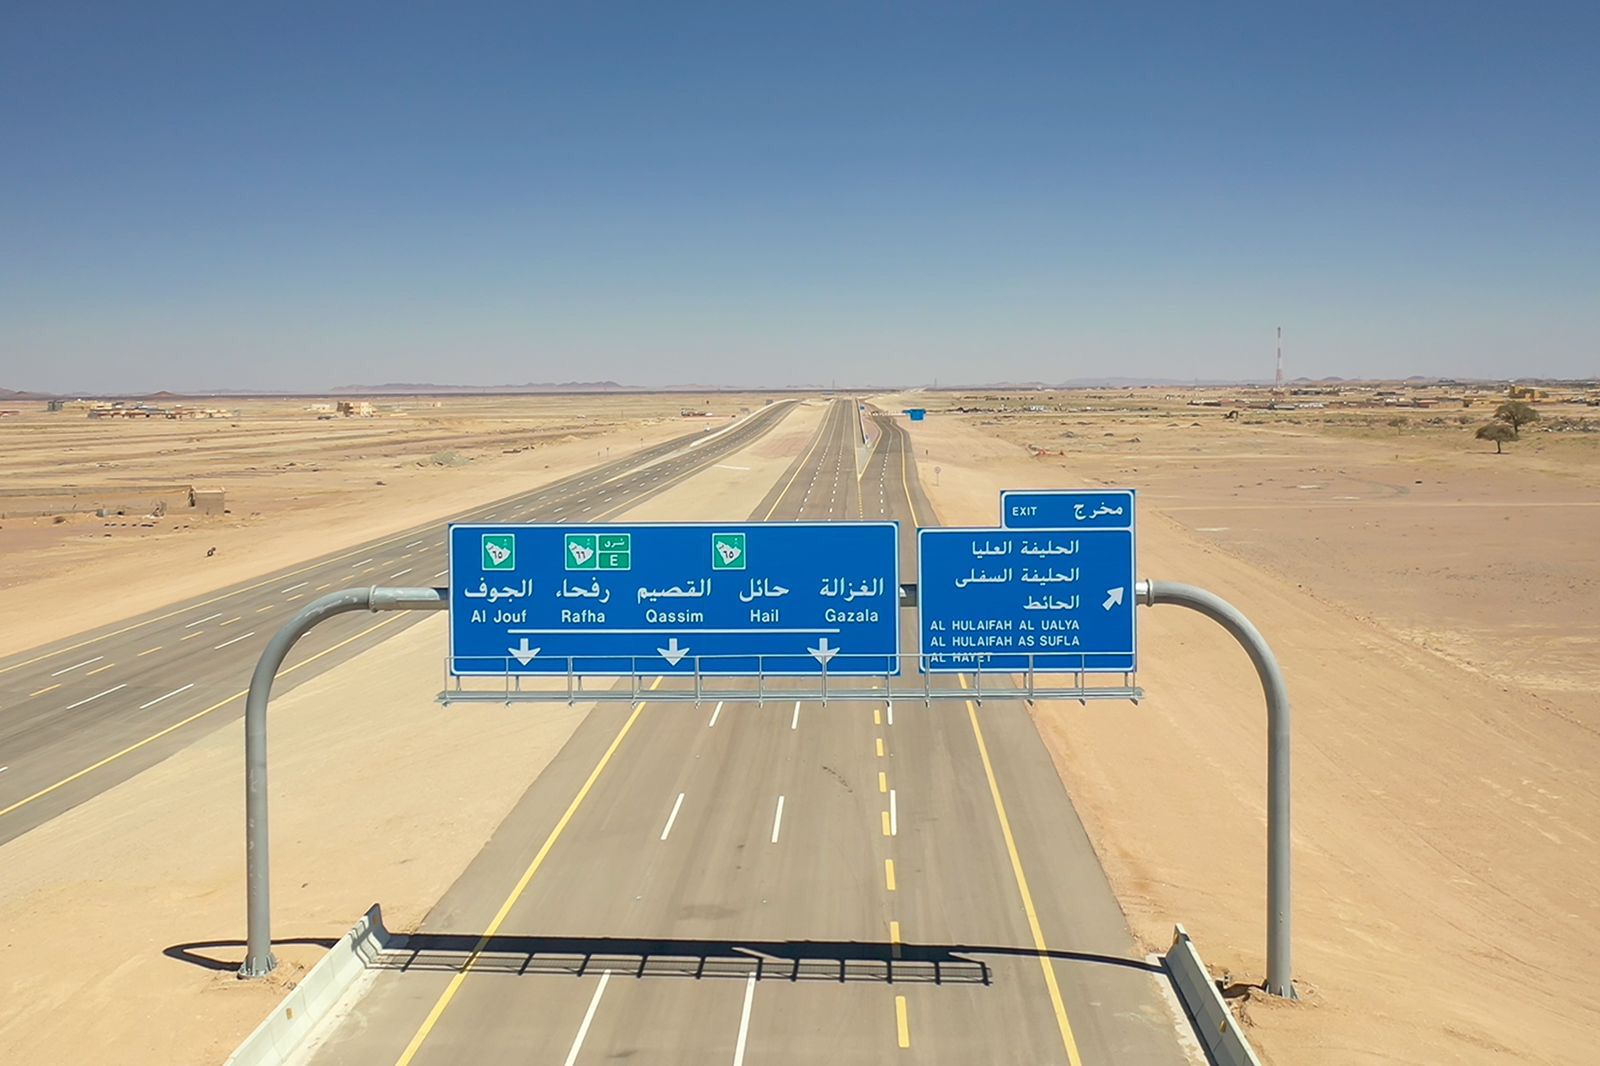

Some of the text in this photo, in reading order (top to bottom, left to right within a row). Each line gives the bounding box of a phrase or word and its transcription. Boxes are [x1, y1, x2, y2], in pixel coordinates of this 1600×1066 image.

[1012, 506, 1037, 516] EXIT
[1073, 502, 1123, 520] مخرج
[972, 540, 1079, 559] الحليفة العليا
[610, 554, 618, 567] E
[955, 567, 1079, 588] الحليفة السفلى
[464, 577, 533, 603] الجوف
[556, 577, 610, 603] رفحاء
[637, 578, 711, 604] القصيم
[739, 578, 790, 602] حائل
[819, 577, 884, 602] الغزالة
[1023, 595, 1079, 610] الحائط
[471, 609, 527, 623] Al Jouf
[561, 609, 605, 623] Rafha
[645, 609, 704, 623] Qassim
[750, 609, 779, 623] Hail
[825, 608, 878, 623] Gazala
[930, 620, 1080, 631] AL HULAIFAH AL UALYA
[930, 635, 1080, 647] AL HULAIFAH AS SUFLA
[930, 652, 946, 663] AL
